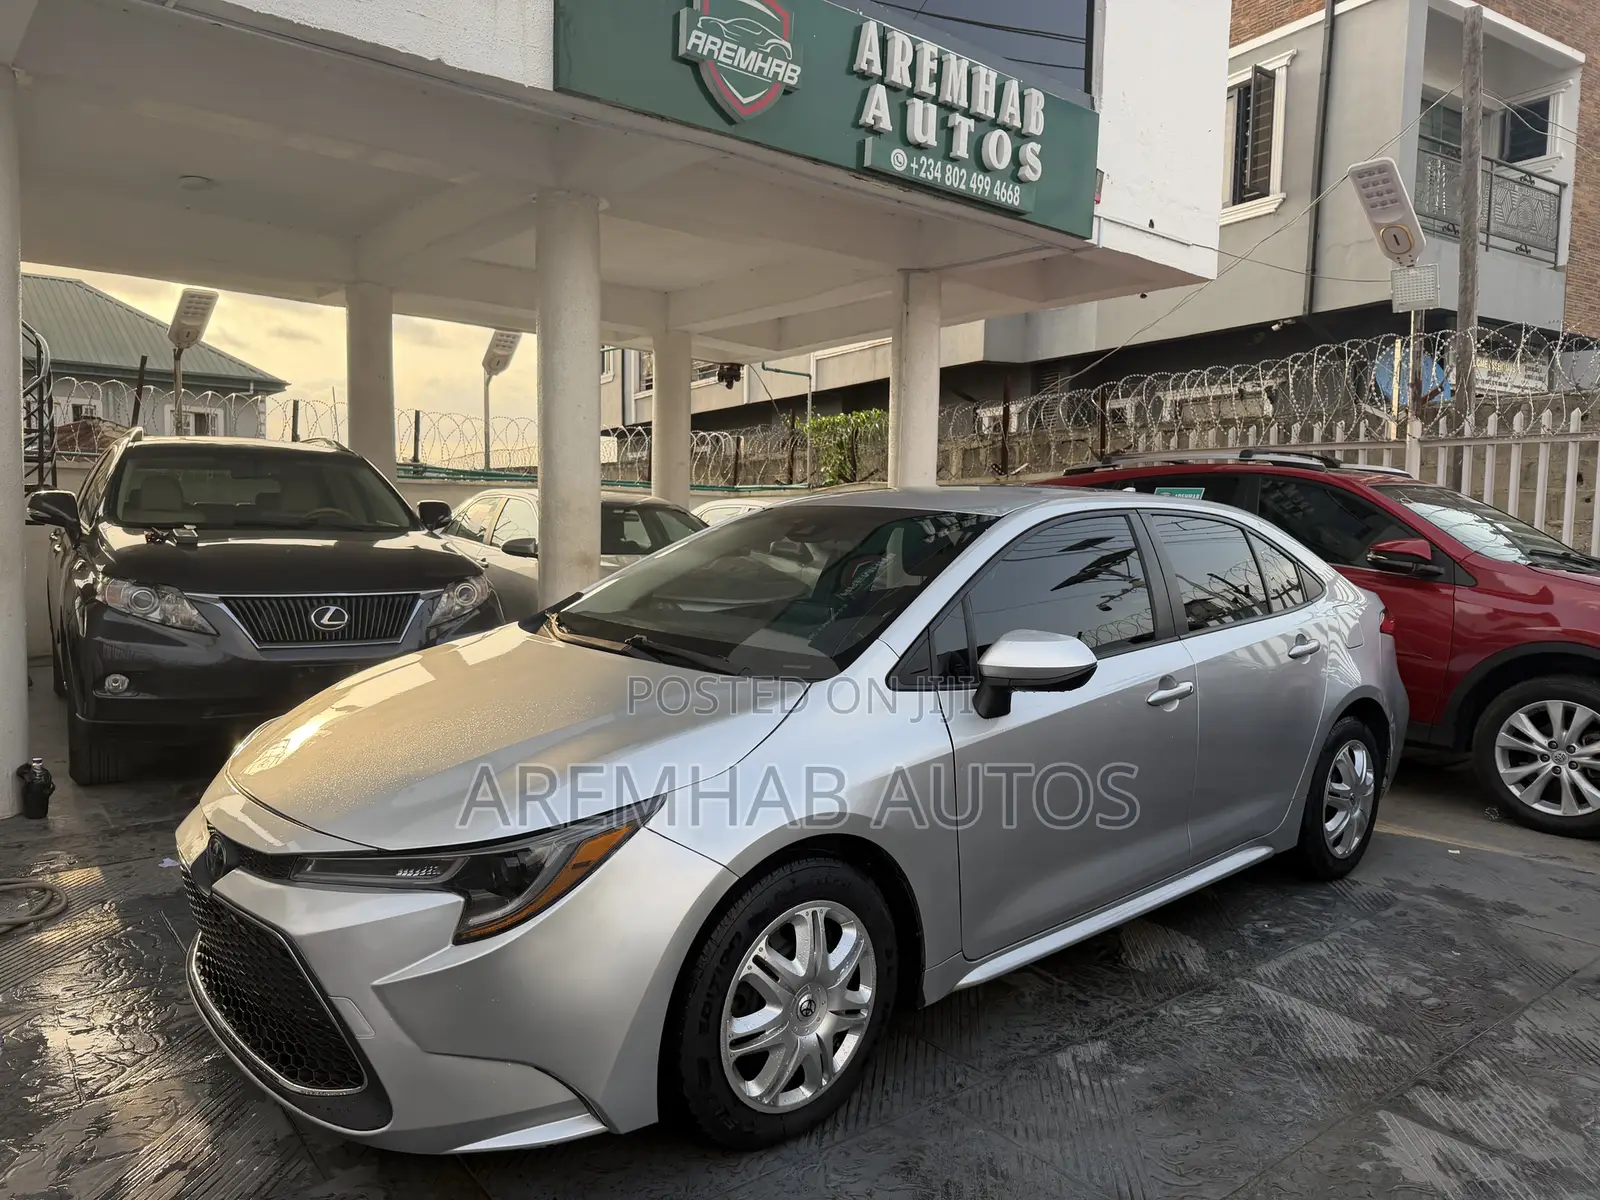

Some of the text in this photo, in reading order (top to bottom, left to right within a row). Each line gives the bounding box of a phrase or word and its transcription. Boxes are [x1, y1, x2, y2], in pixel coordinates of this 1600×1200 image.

[686, 29, 801, 86] AREMHAB
[853, 19, 1045, 138] AREMHAB
[858, 83, 1043, 183] AUTOS
[910, 156, 1020, 206] +234 802 499 4668
